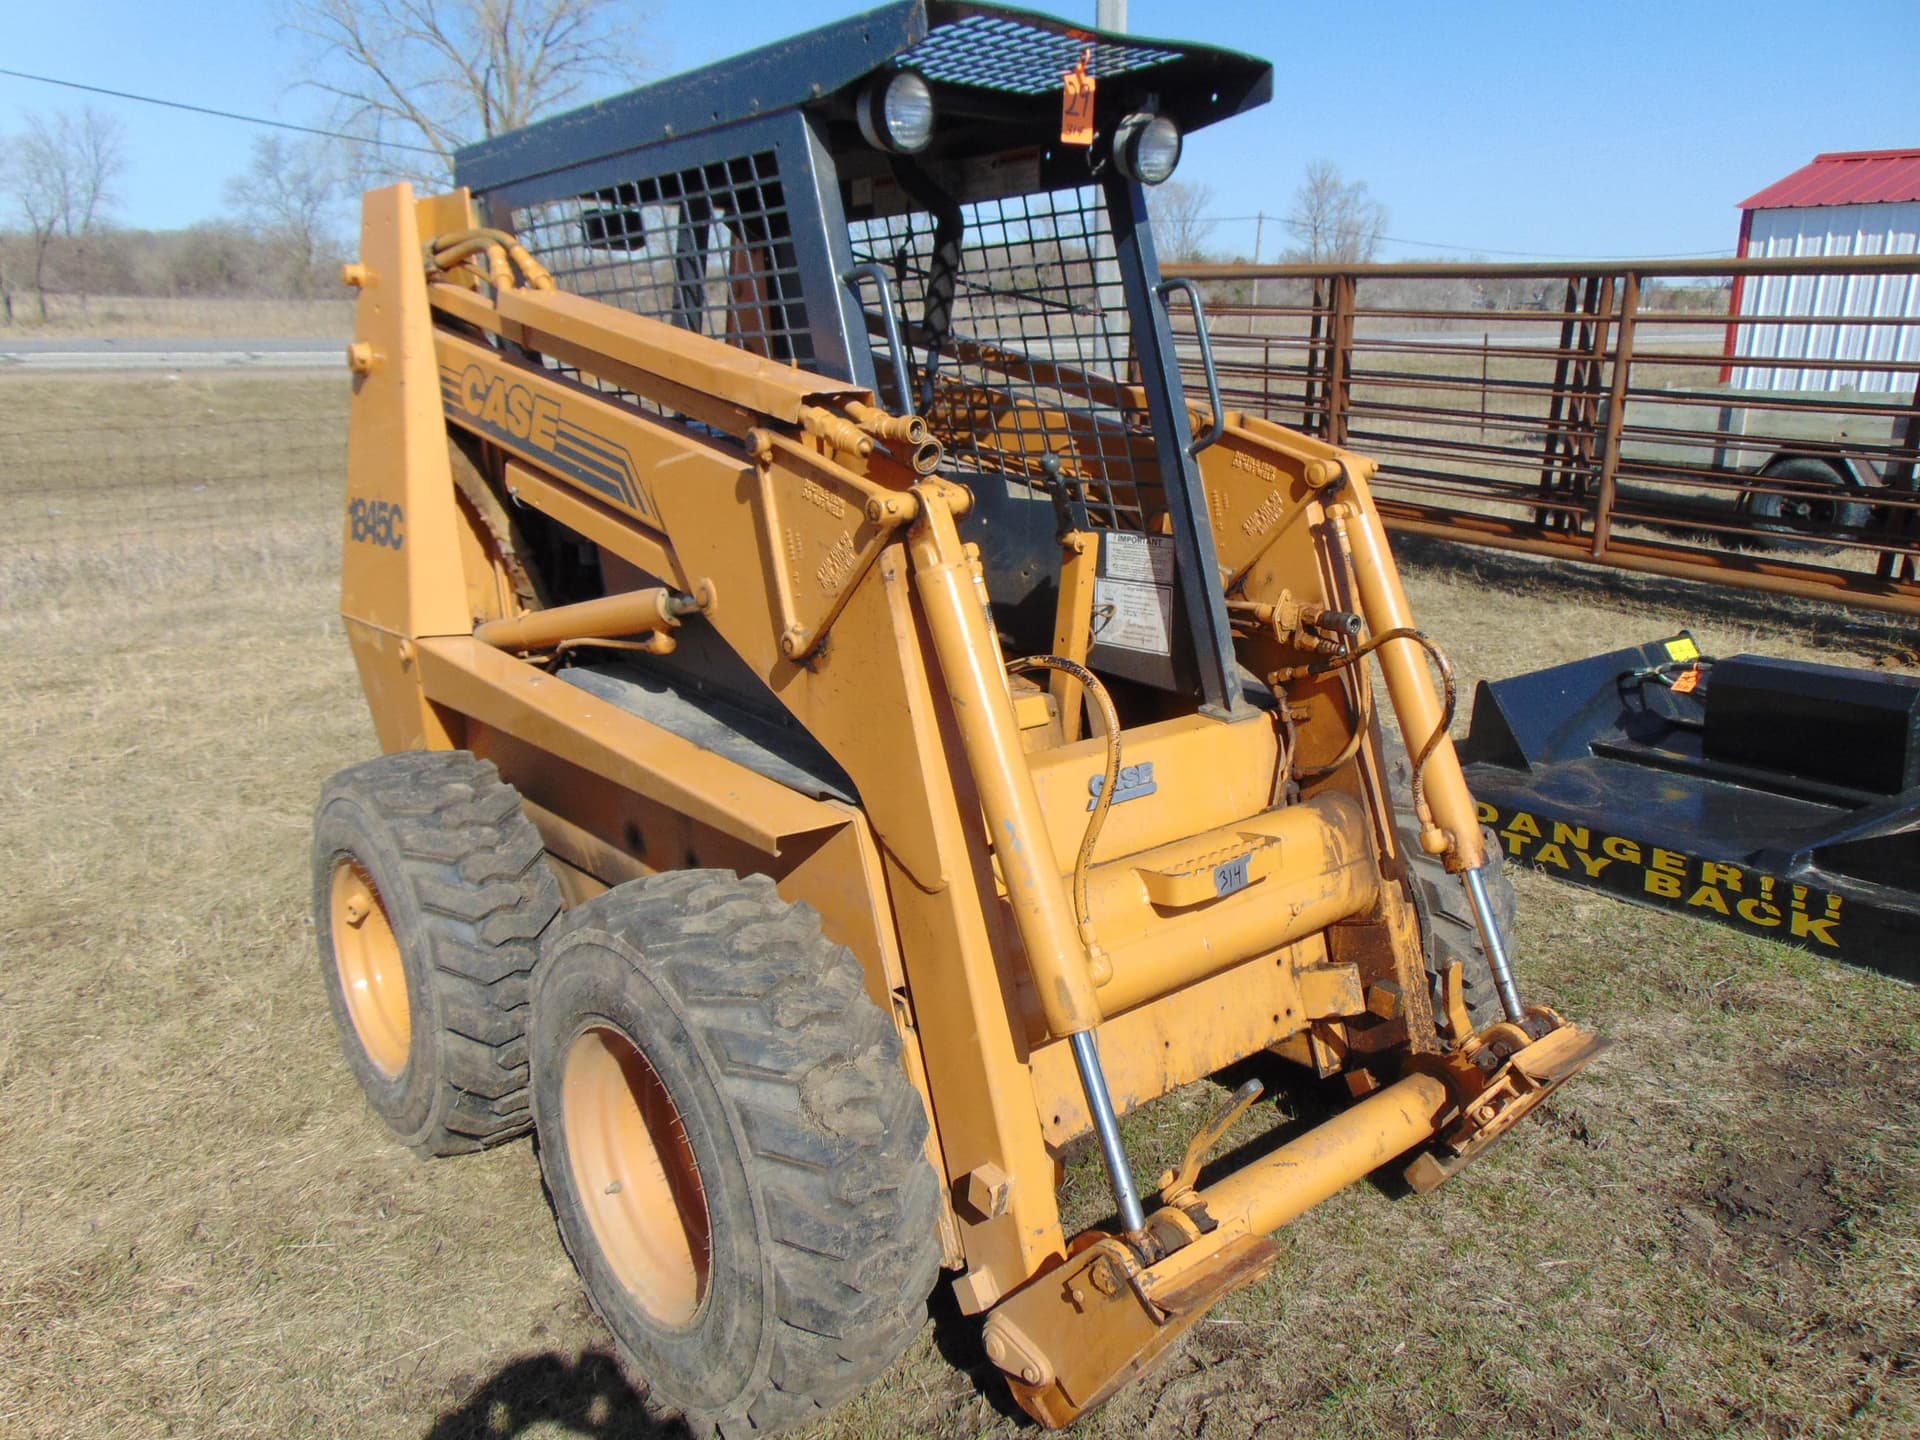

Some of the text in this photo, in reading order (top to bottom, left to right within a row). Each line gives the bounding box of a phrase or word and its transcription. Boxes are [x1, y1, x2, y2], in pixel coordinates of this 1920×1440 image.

[460, 364, 561, 451] CASE
[1117, 534, 1161, 547] IMPORTANT
[1219, 865, 1241, 890] 314
[1500, 830, 1840, 947] TAY BACK
